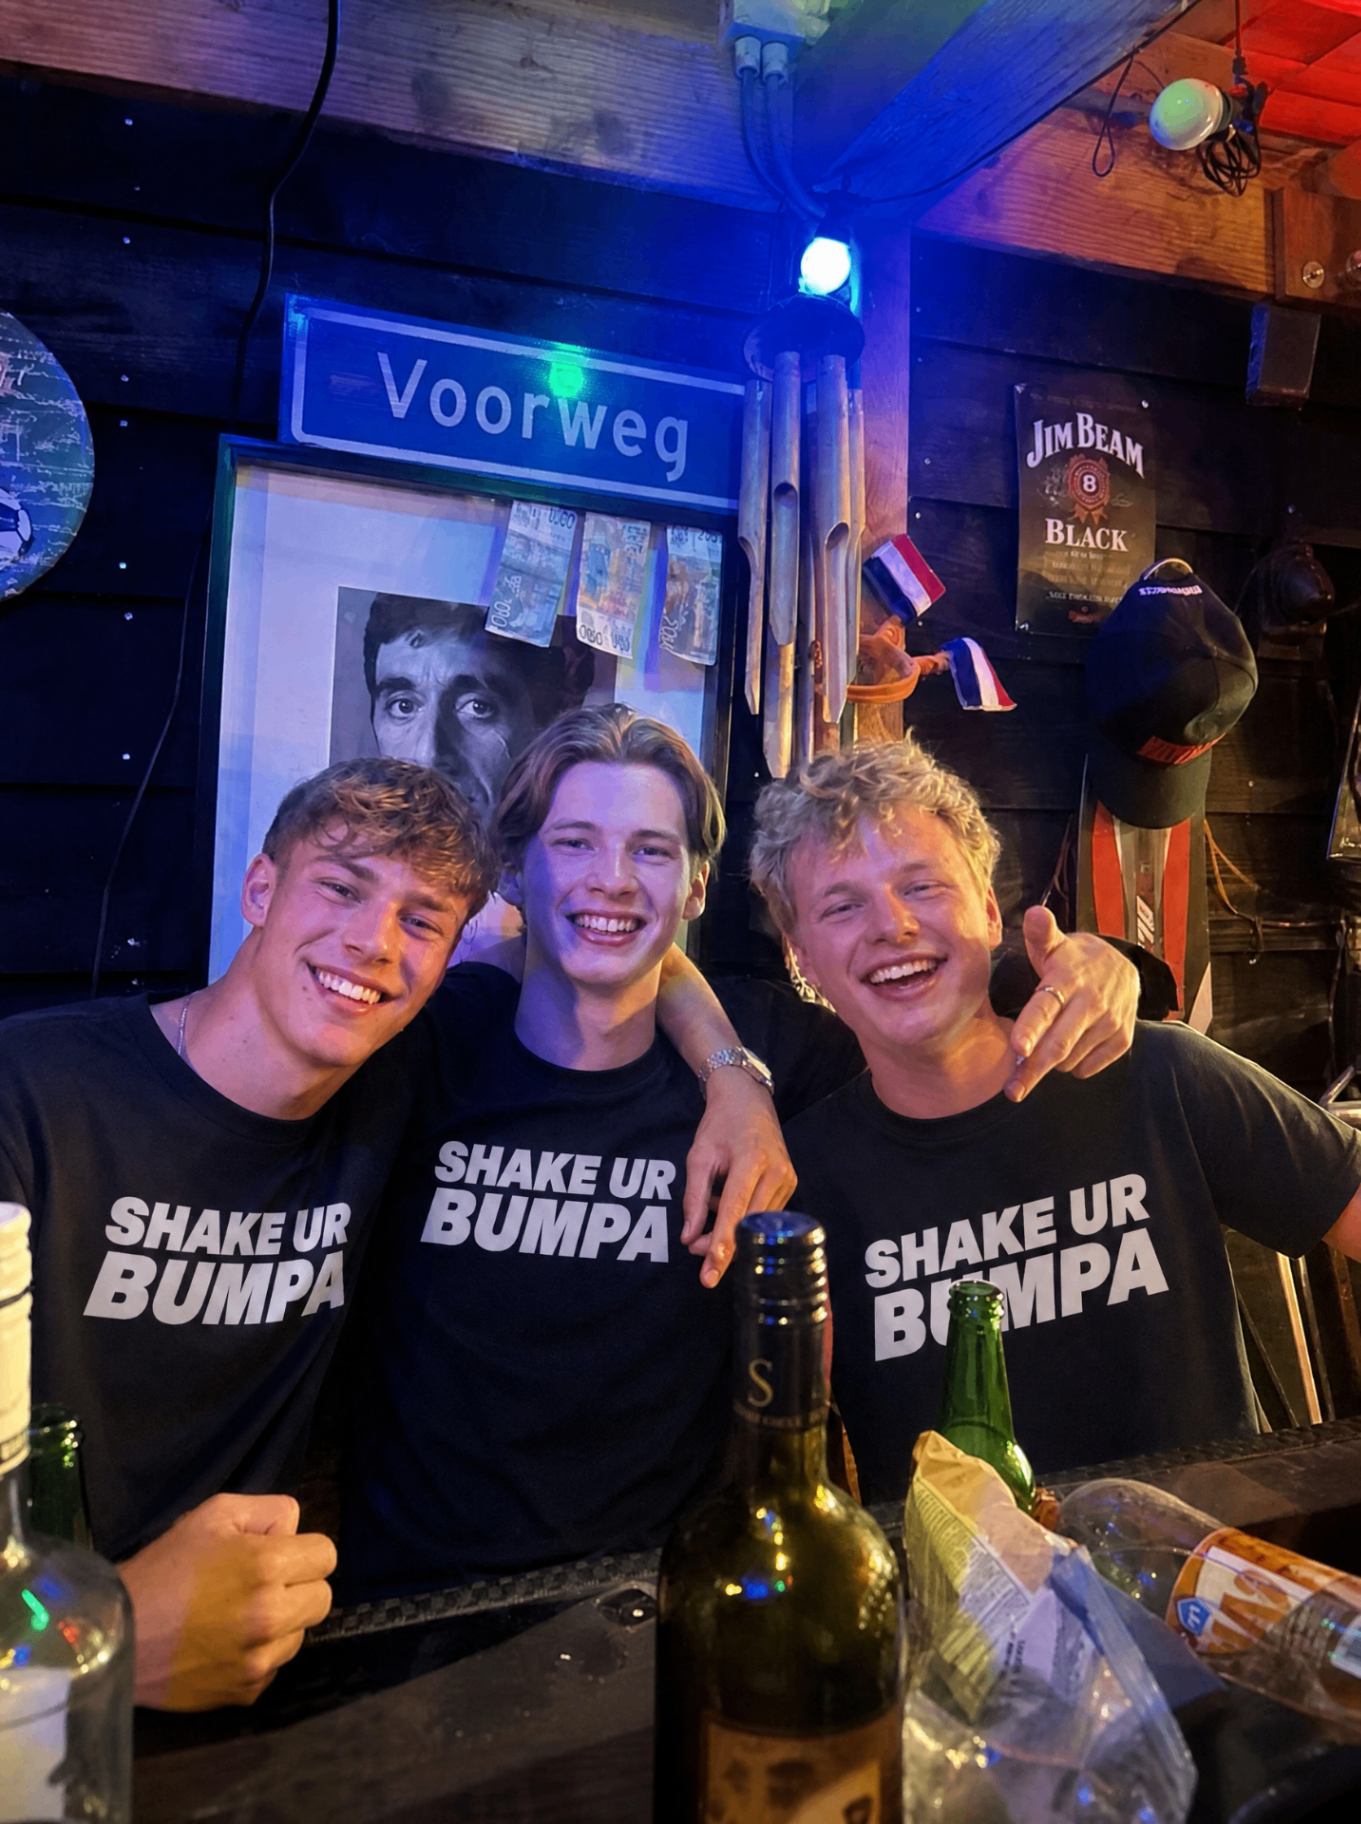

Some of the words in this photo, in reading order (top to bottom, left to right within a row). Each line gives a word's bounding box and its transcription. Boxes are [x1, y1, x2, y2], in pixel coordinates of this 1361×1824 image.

[377, 352, 689, 483] Voorweg
[1026, 419, 1074, 469] JIM
[1076, 412, 1145, 479] BEAM
[1082, 474, 1098, 492] 8
[1045, 518, 1129, 552] BLACK
[434, 1140, 602, 1196] SHAKE
[609, 1157, 676, 1200] UR
[105, 1196, 287, 1256] SHAKE
[292, 1202, 351, 1253] UR
[420, 1187, 669, 1263] BUMPA
[864, 1196, 1057, 1289] SHAKE
[1069, 1173, 1151, 1236] UR
[82, 1250, 345, 1325] BUMPA
[747, 1358, 773, 1408] S
